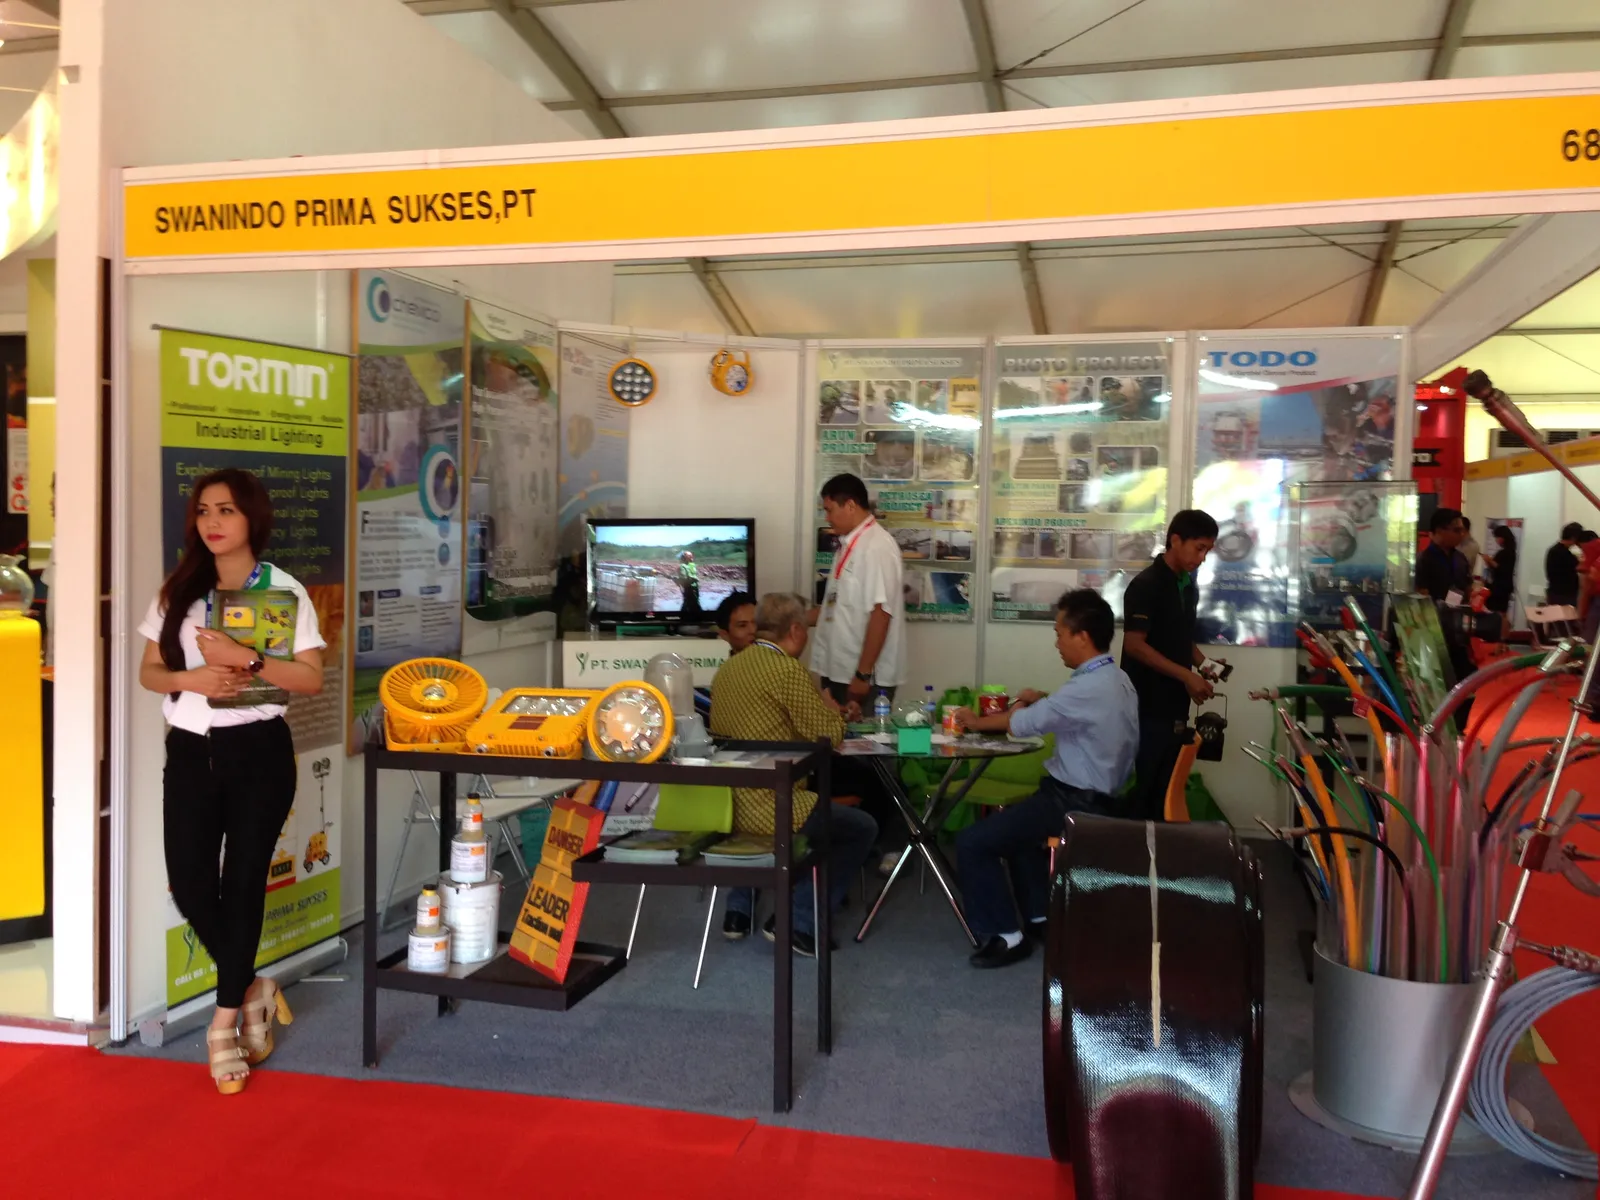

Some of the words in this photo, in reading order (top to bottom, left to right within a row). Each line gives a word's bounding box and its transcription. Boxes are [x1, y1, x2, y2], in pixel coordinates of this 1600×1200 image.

[155, 201, 284, 233] SWANINDO
[295, 197, 376, 227] PRIMA
[1002, 357, 1069, 372] PHOTO
[1075, 355, 1168, 371] PROJECT
[1208, 350, 1317, 367] TODO
[196, 421, 265, 441] Industrial
[271, 427, 323, 448] Lighting
[302, 467, 332, 483] Lights
[300, 488, 329, 502] Lights
[292, 507, 319, 521] Lights
[548, 826, 584, 857] DANGER
[528, 884, 569, 923] LEADER
